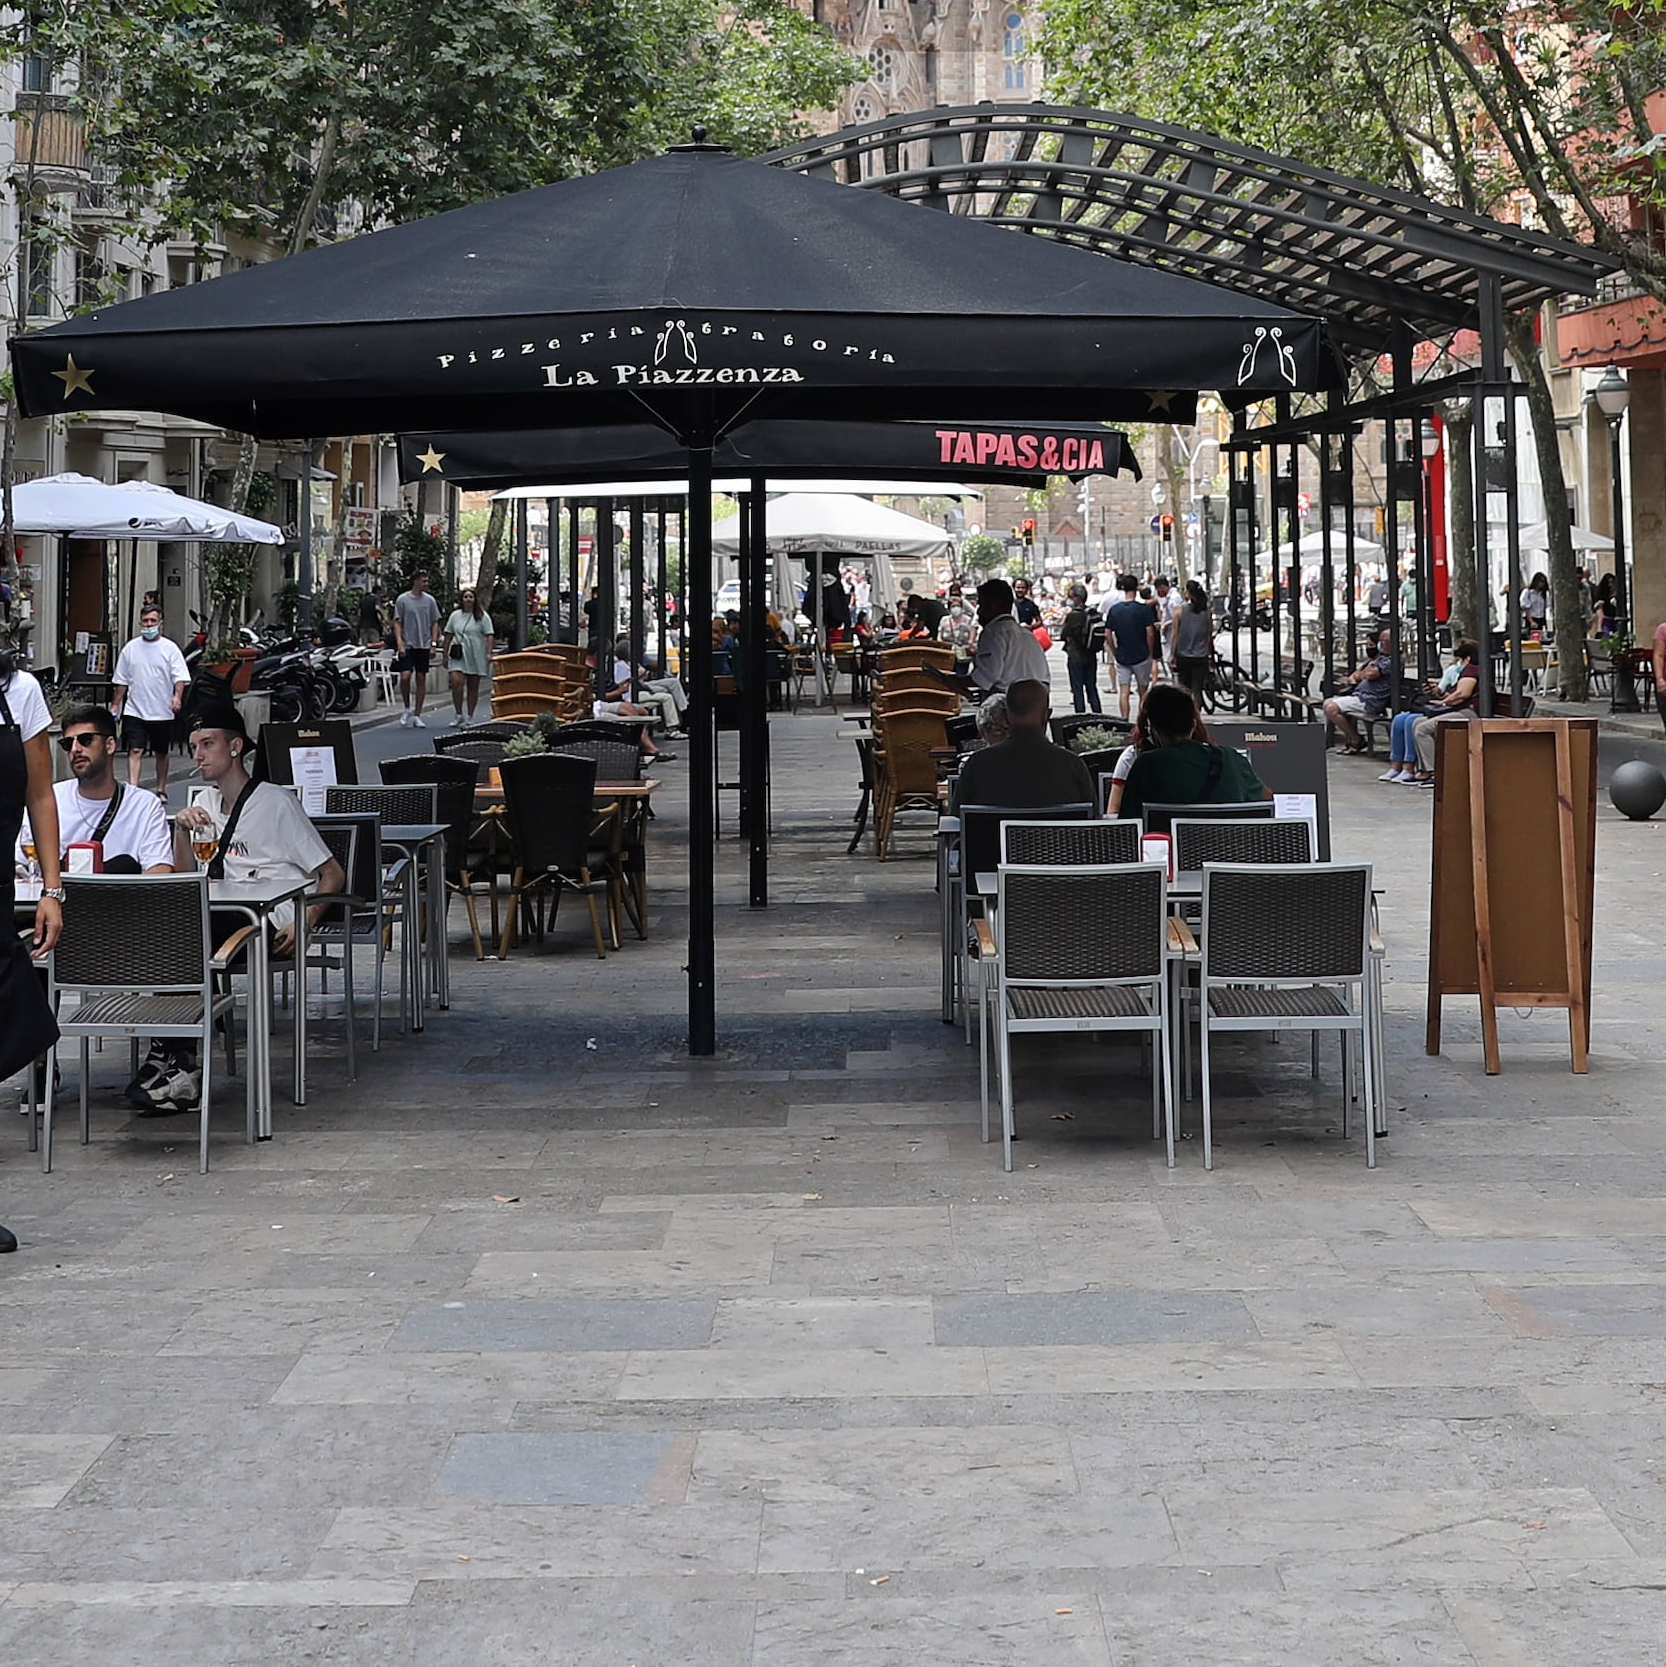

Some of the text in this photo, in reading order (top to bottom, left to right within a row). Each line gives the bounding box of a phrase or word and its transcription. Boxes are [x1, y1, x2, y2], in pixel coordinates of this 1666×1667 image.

[436, 321, 897, 369] Pizzeria tratoria
[541, 363, 805, 388] La Piazzenza
[934, 429, 1105, 472] TAPAS&CIA
[854, 540, 901, 552] PAELLAS
[1244, 732, 1278, 743] Mahou
